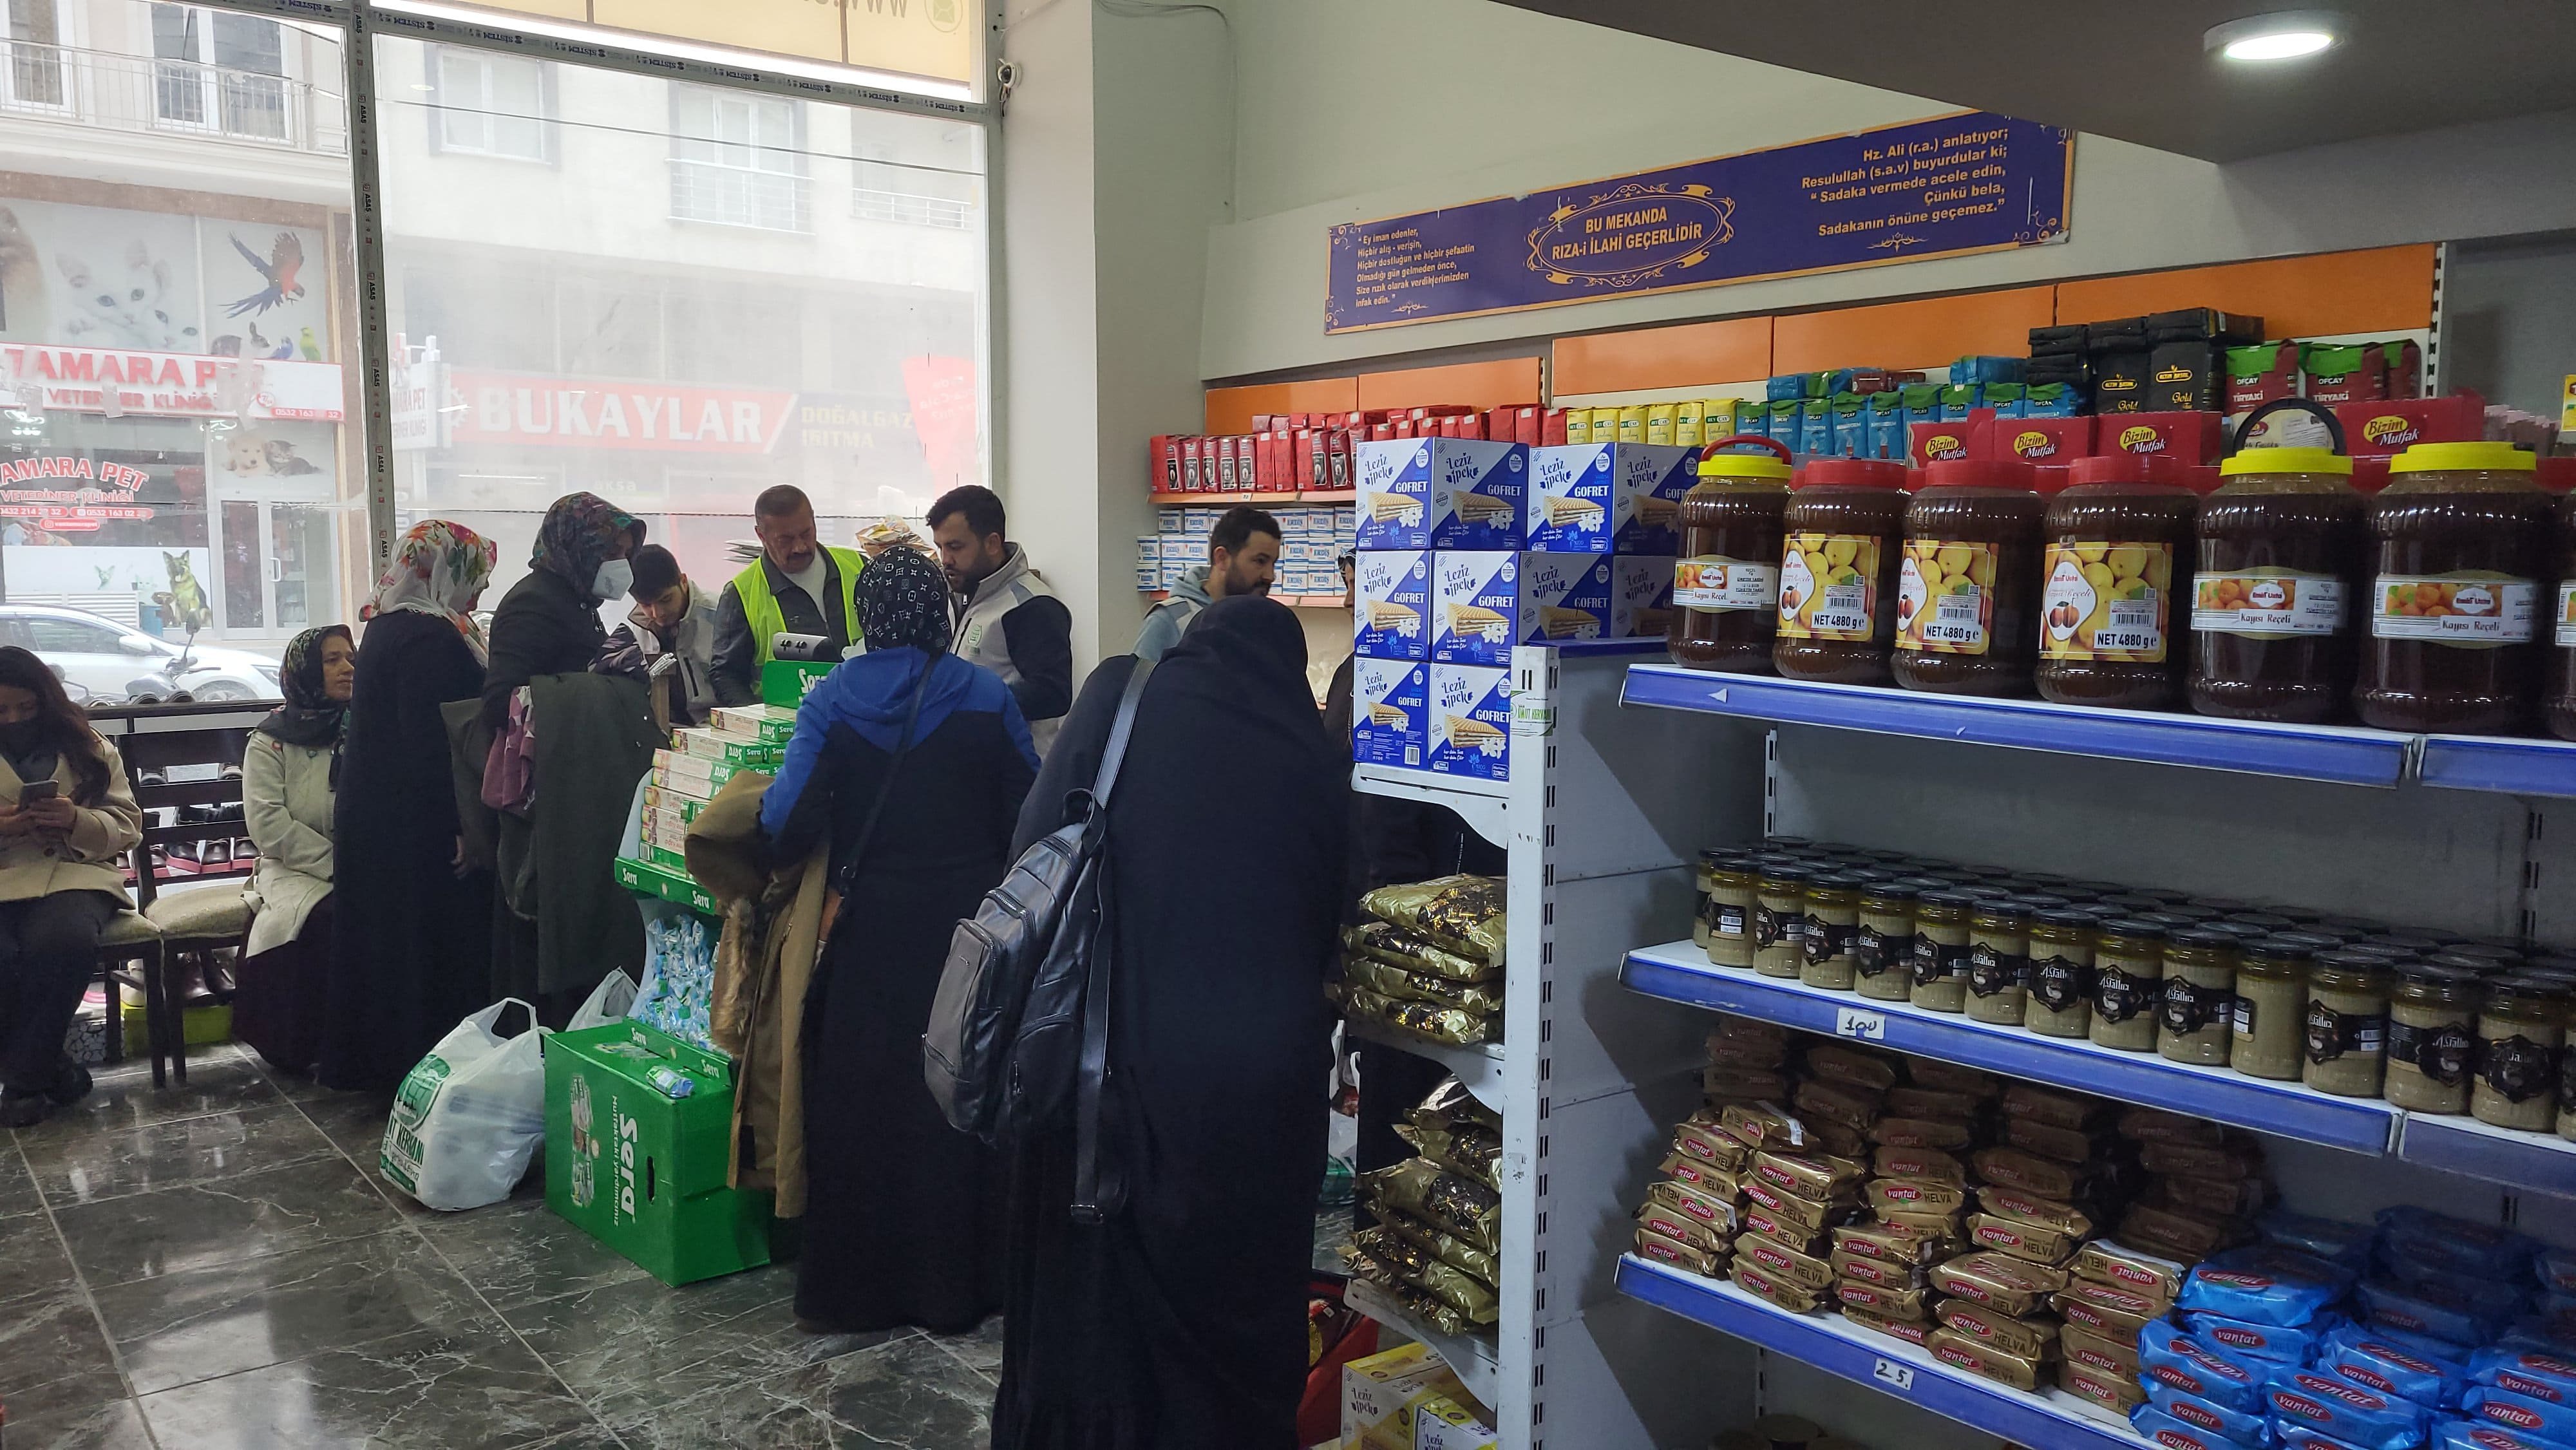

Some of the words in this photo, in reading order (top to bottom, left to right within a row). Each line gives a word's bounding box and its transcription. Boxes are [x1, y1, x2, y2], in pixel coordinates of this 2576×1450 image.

[1864, 149, 1883, 162] Hz.
[1887, 144, 1904, 158] Ali
[1909, 138, 1938, 156] (r.a.)
[1943, 129, 2008, 148] anlatıyor;
[1802, 168, 1866, 189] Resulullah
[1870, 162, 1909, 181] (s.a.v)
[1913, 150, 1986, 171] buyurdular
[1991, 146, 2007, 158] ki;
[1820, 187, 1866, 203] Sadaka
[1870, 177, 1927, 194] vermede
[1931, 170, 1967, 185] acele
[1972, 164, 2005, 178] edin,
[1924, 186, 1966, 206] Çünkü
[1971, 182, 2005, 196] bela,
[1586, 217, 1602, 233] BU
[1606, 207, 1667, 230] MEKANDA
[1818, 217, 1884, 236] Sadakanın
[1888, 214, 1928, 226] önüne
[1373, 233, 1389, 243] iman
[1391, 228, 1418, 240] edenler,
[1590, 233, 1622, 254] İLAHİ
[1625, 221, 1702, 250] GEÇERLİDİR
[1358, 247, 1378, 258] Hiçbir
[1379, 245, 1392, 254] alış
[1397, 240, 1422, 251] verişin,
[1358, 259, 1377, 270] Hiçbir
[1379, 255, 1412, 266] dostluğun
[1424, 249, 1443, 260] hiçbir
[1445, 244, 1475, 258] şefaatin
[1357, 271, 1386, 283] Olmadığı
[1388, 268, 1400, 279] gün
[1401, 264, 1435, 278] gelmeden
[1356, 286, 1370, 295] Size
[1388, 279, 1408, 290] olarak
[299, 410, 314, 418] 163
[480, 388, 761, 443] BUKAYLAR
[2369, 419, 2405, 435] Bizim
[2018, 433, 2045, 447] Bizim
[2125, 429, 2153, 444] Bizim
[2380, 429, 2420, 446] Mutfak
[1929, 439, 1956, 452] Bizim
[2027, 443, 2056, 458] Mutfak
[2133, 439, 2166, 453] Mutfak
[1937, 447, 1967, 461] Mutfak
[100, 461, 149, 492] PET
[1396, 482, 1428, 493] GOFRET
[1487, 485, 1522, 496] GOFRET
[1575, 485, 1609, 497] GOFRET
[1394, 592, 1425, 603] GOFRET
[1479, 596, 1515, 608] GOFRET
[1574, 597, 1608, 608] GOFRET
[1814, 614, 1829, 626] NET
[1832, 615, 1850, 627] 4880
[1852, 619, 1857, 629] g
[2240, 613, 2264, 625] Kayısı
[2267, 613, 2291, 624] Reçeli
[2442, 619, 2469, 632] Kayısı
[2473, 620, 2500, 632] Reçeli
[1926, 625, 1942, 637] NET
[1944, 626, 1964, 638] 4880
[1965, 630, 1971, 641] g
[2097, 633, 2117, 646] NET
[2119, 633, 2141, 646] 4880
[2143, 637, 2149, 648] g
[1397, 697, 1422, 707] GOFRET
[623, 867, 637, 885] Sera
[692, 890, 710, 909] Sera
[701, 1060, 720, 1078] Sera
[1687, 1140, 1710, 1156] vantat
[620, 1113, 638, 1218] Sera
[1761, 1167, 1790, 1183] vantat
[1702, 1178, 1727, 1194] HELVA
[1749, 1189, 1777, 1206] vantat
[1888, 1189, 1917, 1199] vantat
[1924, 1192, 1952, 1204] HELVA
[2002, 1198, 2034, 1214] vantat
[1848, 1241, 1876, 1254] vantat
[1982, 1229, 2016, 1244] vantat
[2023, 1243, 2054, 1257] HELVA
[1756, 1250, 1787, 1267] vantat
[1795, 1266, 1824, 1285] HELVA
[1743, 1274, 1769, 1291] vantat
[1776, 1291, 1803, 1310] HELVA
[1950, 1282, 1984, 1299] vantat
[2069, 1306, 2103, 1326] vantat
[1954, 1315, 1985, 1333] vantat
[1994, 1333, 2028, 1353] HELVA
[2217, 1330, 2257, 1345] vantat
[1942, 1348, 1974, 1366] vantat
[2344, 1368, 2387, 1389] vantat
[2076, 1379, 2110, 1398] vantat
[2485, 1405, 2532, 1425] vantat
